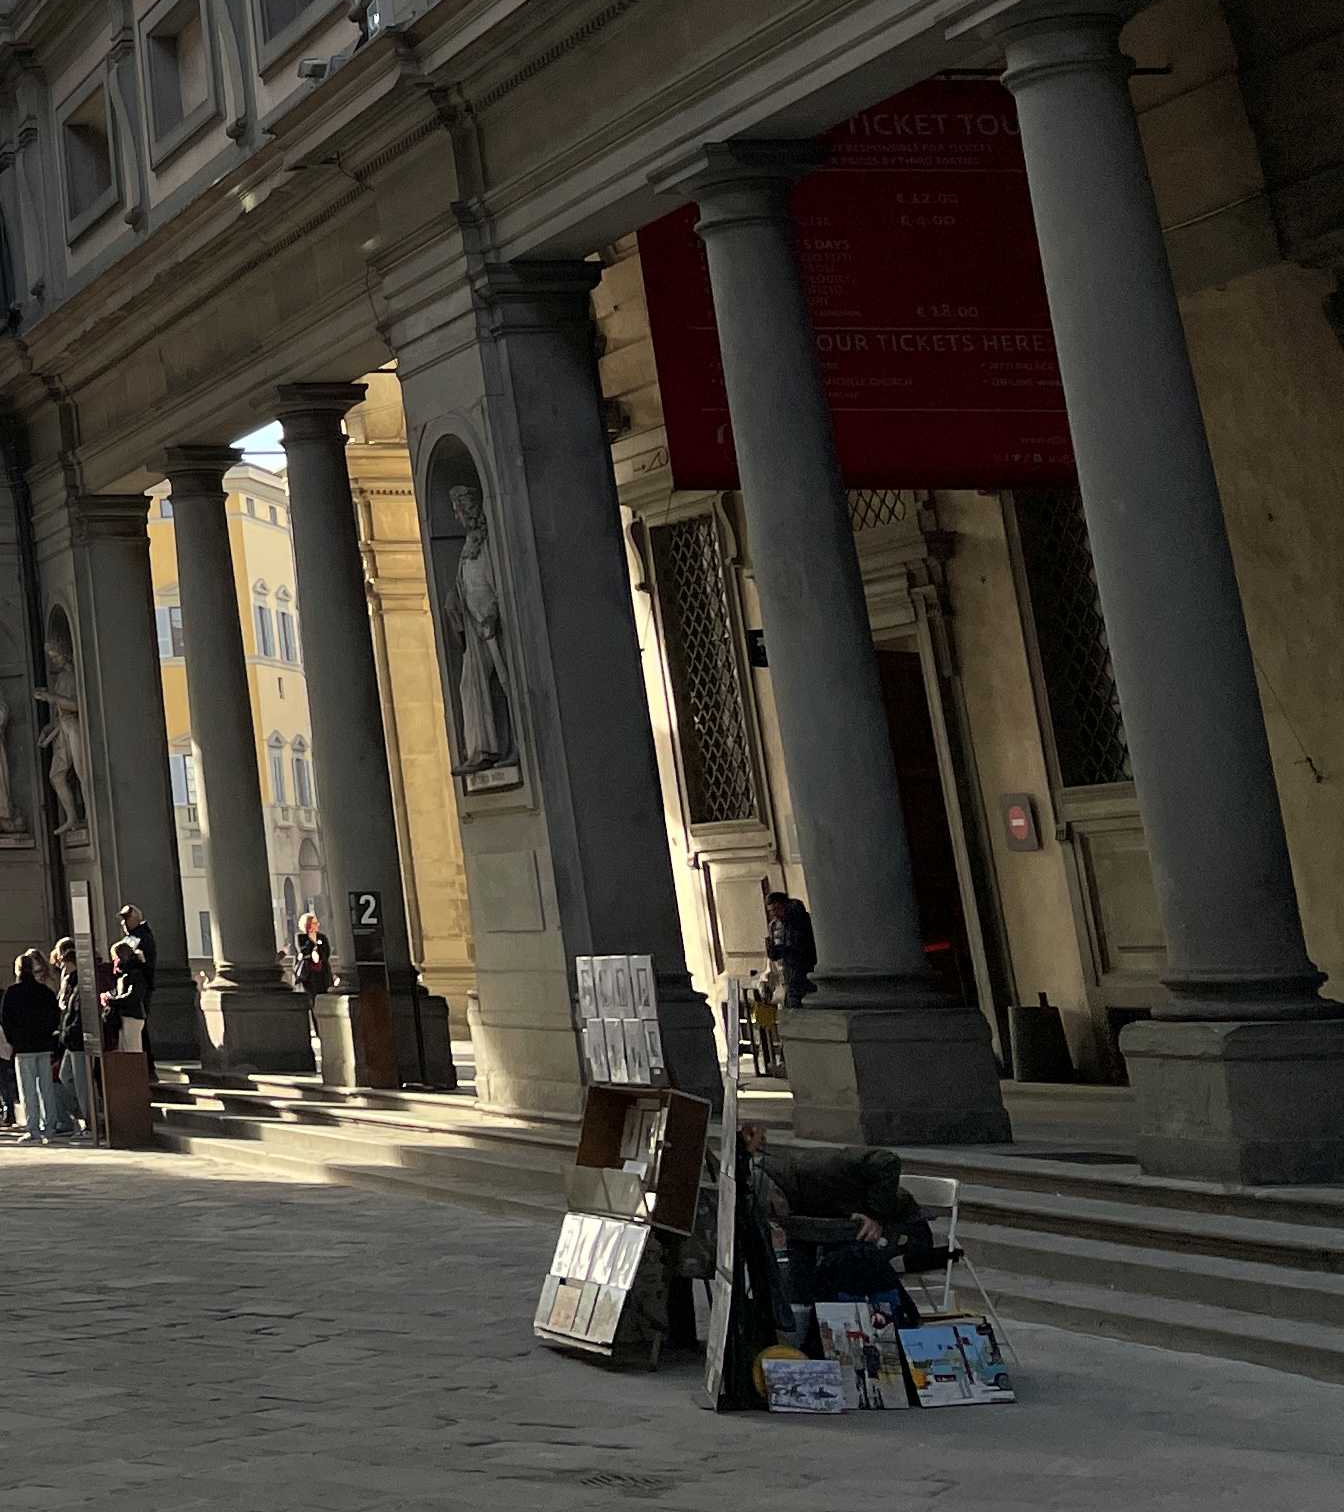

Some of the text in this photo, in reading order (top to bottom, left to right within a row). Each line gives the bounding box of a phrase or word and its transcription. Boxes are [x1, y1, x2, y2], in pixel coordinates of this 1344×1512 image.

[848, 113, 948, 136] TICKET
[815, 240, 850, 250] DAYS
[877, 334, 975, 352] TICKETS
[359, 894, 378, 925] 2
